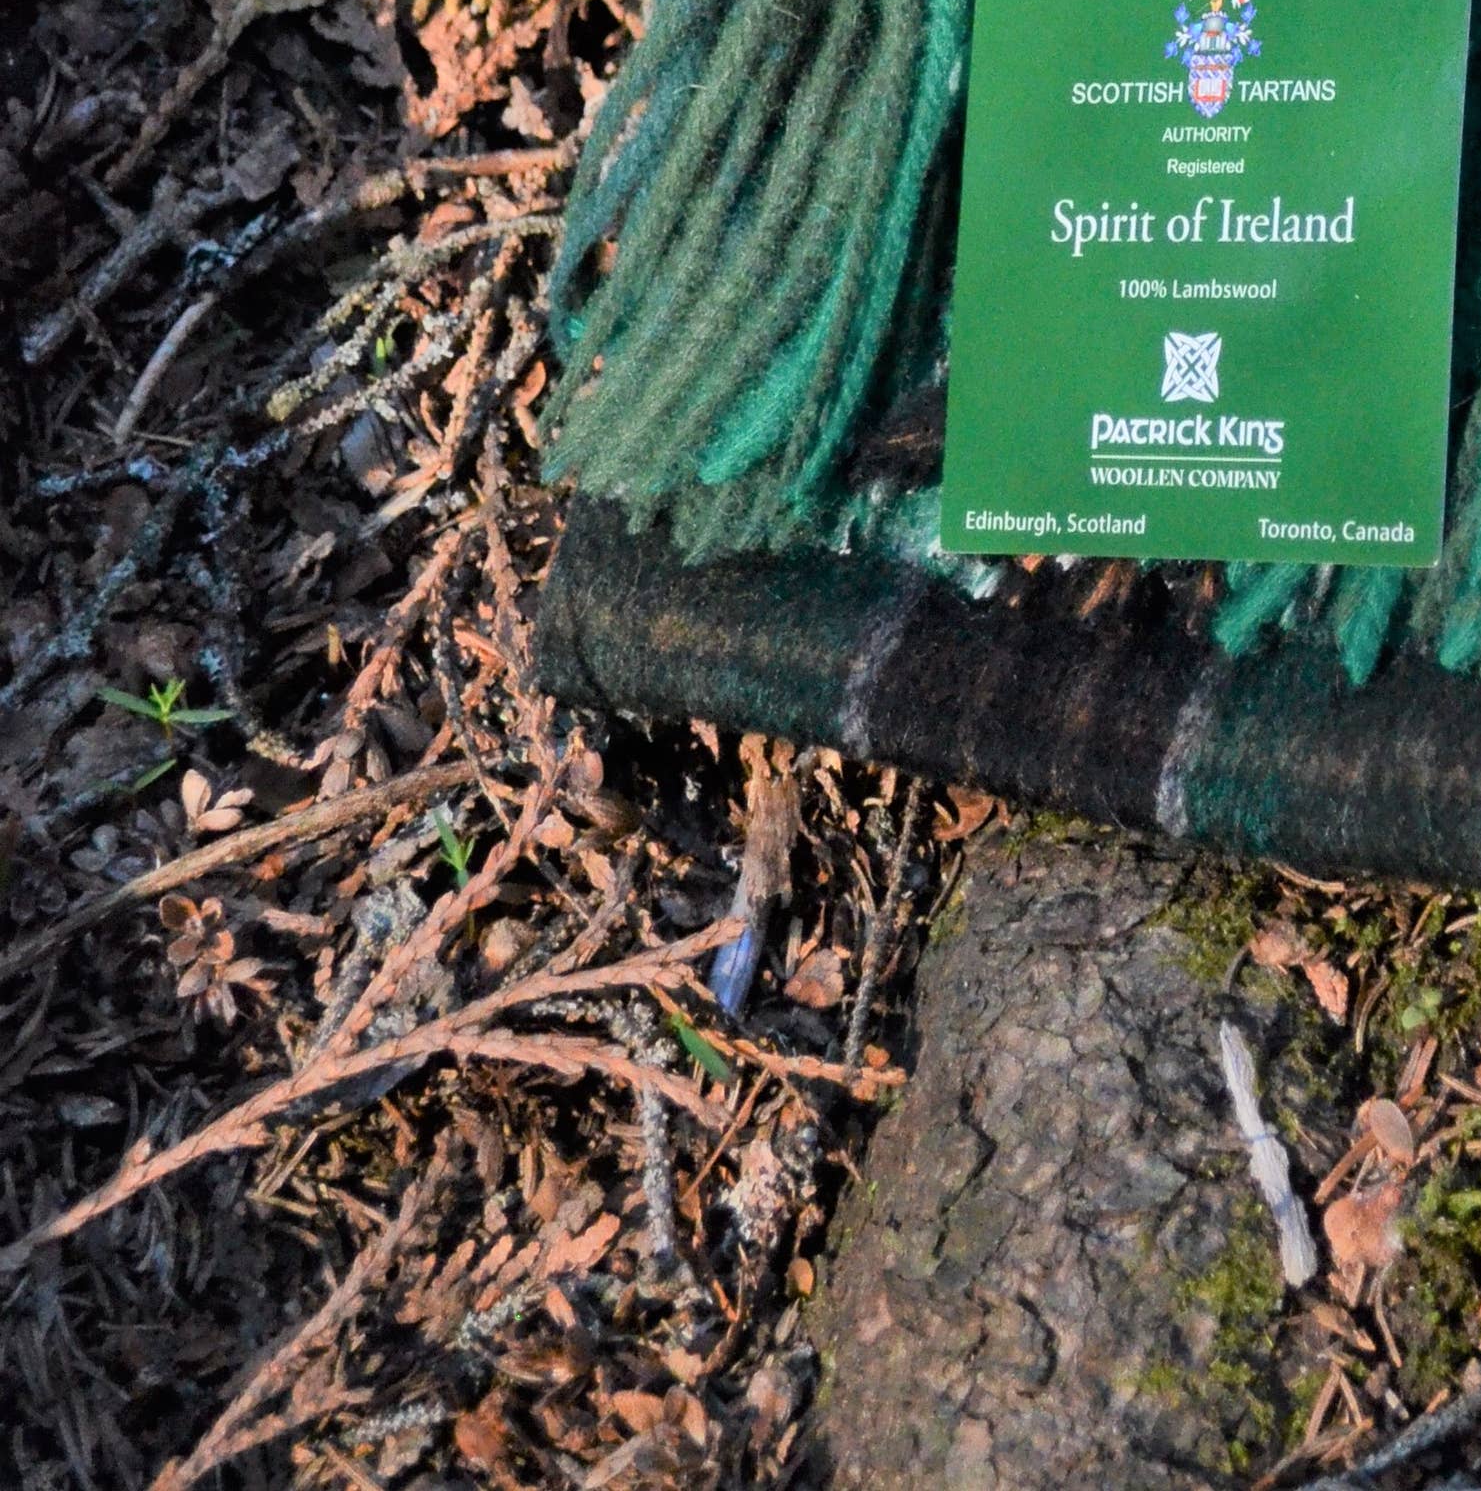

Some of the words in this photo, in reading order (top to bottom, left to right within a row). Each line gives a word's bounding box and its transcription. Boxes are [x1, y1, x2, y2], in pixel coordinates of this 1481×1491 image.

[1071, 81, 1184, 105] SCOTTISH
[1238, 79, 1336, 102] TARTANS
[1161, 125, 1252, 144] AUTHORITY
[1166, 158, 1245, 178] Registered
[1050, 198, 1155, 258] Spirit
[1166, 195, 1212, 243] of
[1217, 195, 1355, 244] Ireland
[1119, 279, 1168, 299] 100%
[1172, 278, 1277, 300] Lambswool
[1090, 466, 1185, 487] WOOLLEN
[1187, 469, 1281, 490] COMPANY
[965, 510, 1062, 537] Edinburgh,
[1067, 513, 1146, 536] Scotland
[1258, 517, 1337, 544] Toronto,
[1342, 520, 1415, 544] Canada
